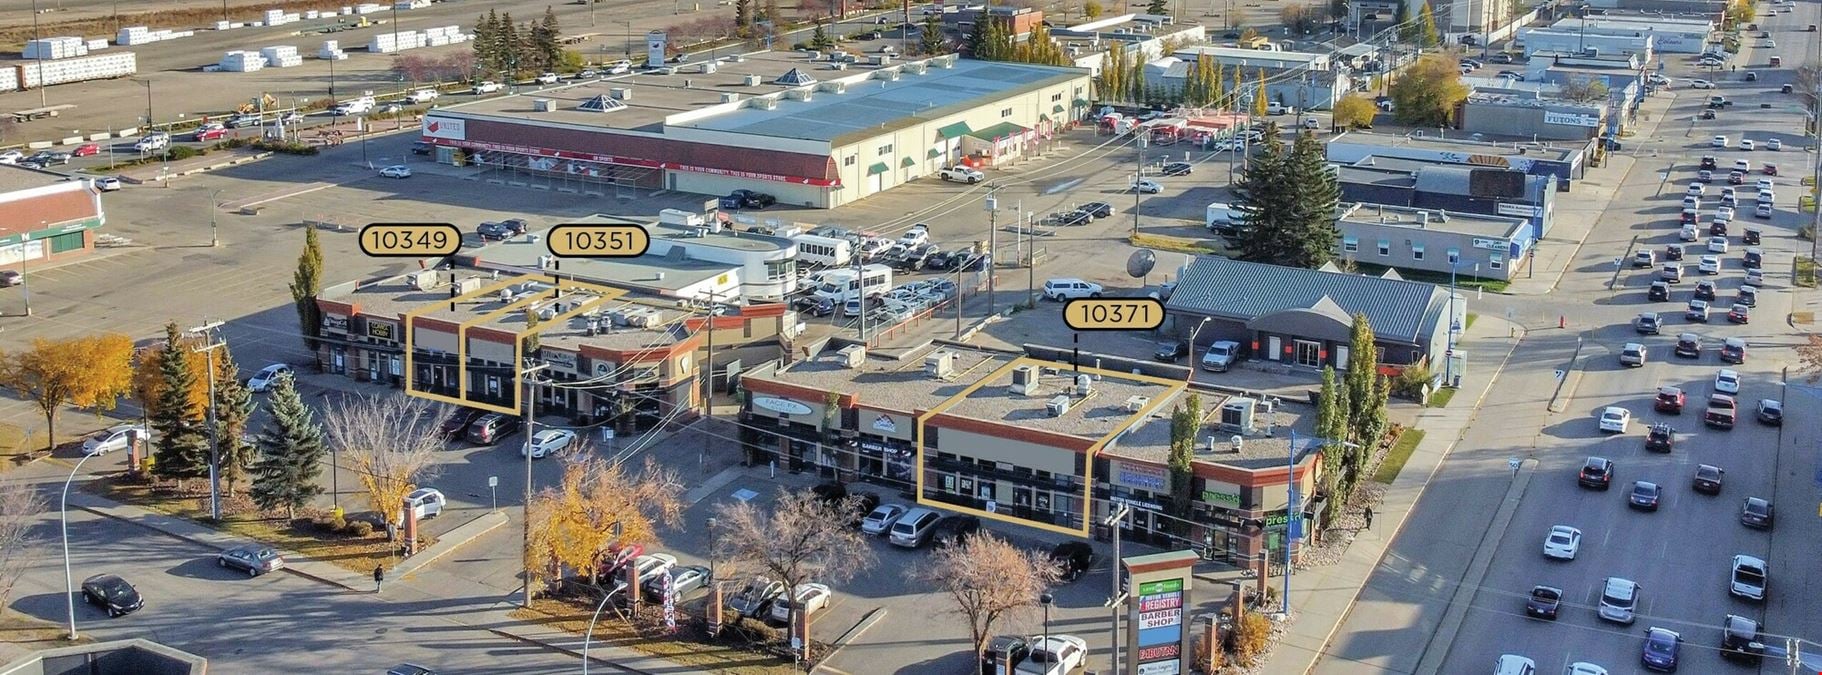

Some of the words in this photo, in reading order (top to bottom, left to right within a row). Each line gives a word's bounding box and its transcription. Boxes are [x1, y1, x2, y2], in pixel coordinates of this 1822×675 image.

[1547, 116, 1581, 124] FUTONS
[861, 442, 882, 451] BARBER
[1145, 598, 1180, 611] REGISTRY
[1141, 609, 1180, 621] BARBER
[1147, 617, 1174, 628] SHOP
